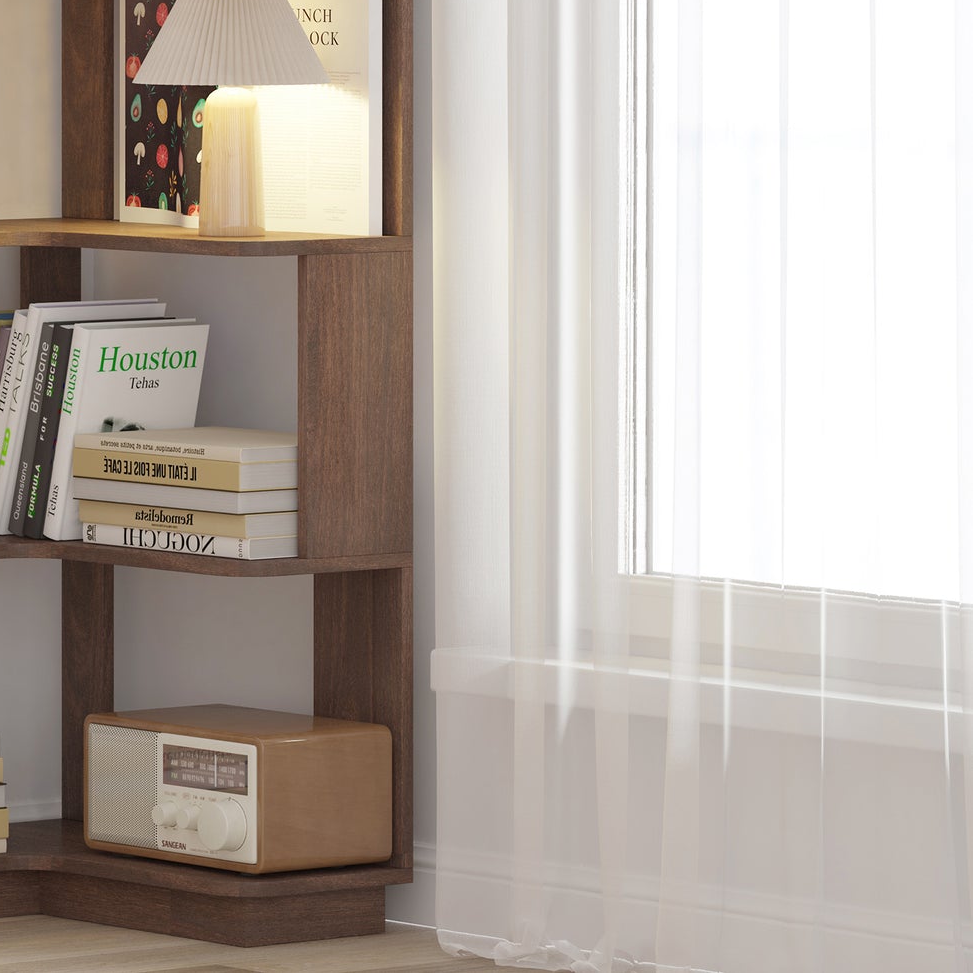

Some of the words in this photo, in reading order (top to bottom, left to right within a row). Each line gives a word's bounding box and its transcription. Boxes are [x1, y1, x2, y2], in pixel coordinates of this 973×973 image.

[30, 342, 49, 413] Brisbane
[62, 348, 80, 416] Houston
[96, 346, 197, 372] Houston
[130, 376, 160, 389] Tehas
[0, 428, 11, 467] TED
[28, 464, 42, 518] FORMULA
[40, 416, 48, 442] FOR
[46, 344, 60, 397] SUCCESS
[14, 462, 28, 520] Queensland
[161, 840, 187, 850] SANGEAN
